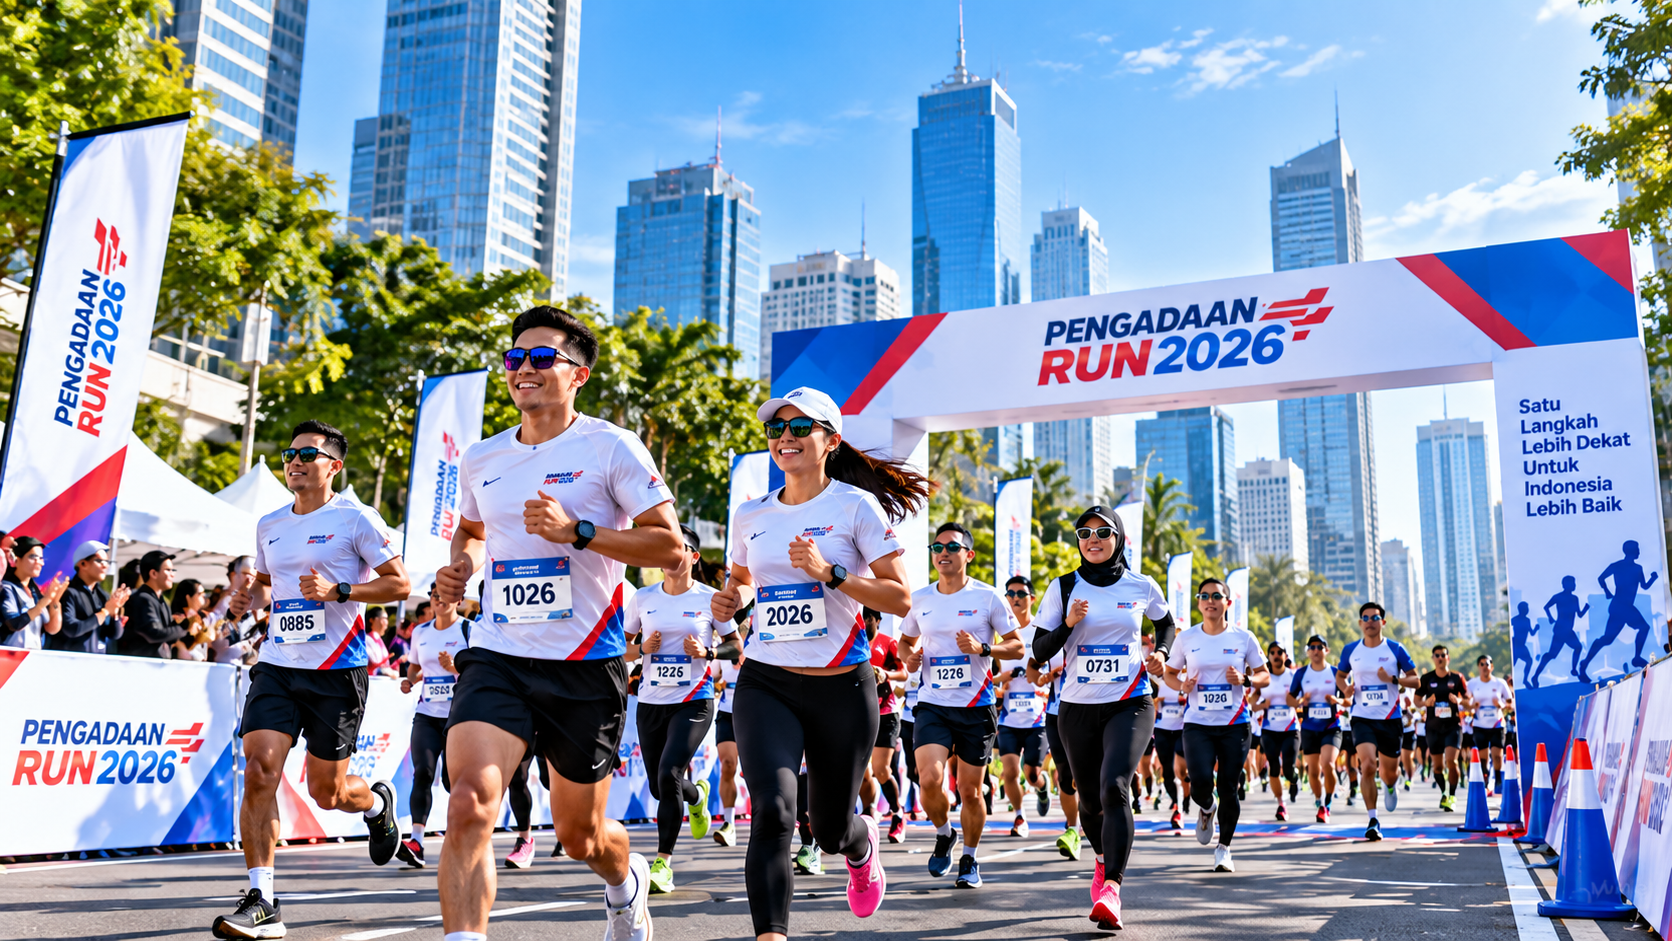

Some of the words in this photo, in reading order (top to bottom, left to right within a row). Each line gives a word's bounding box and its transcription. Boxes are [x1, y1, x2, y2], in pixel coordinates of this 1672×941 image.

[91, 279, 127, 365] 2026
[1044, 296, 1258, 346] PENGADAAN
[54, 269, 100, 427] PENGADAAN
[1037, 338, 1153, 387] RUN
[1152, 324, 1286, 375] 2026
[76, 361, 114, 437] RUN
[1519, 398, 1561, 414] Satu
[1521, 413, 1598, 435] Langkah
[1522, 436, 1572, 454] Lebih
[1576, 432, 1631, 450] Dekat
[1523, 457, 1579, 476] Untuk
[1525, 476, 1613, 496] Indonesia
[1526, 499, 1577, 517] Lebih
[1582, 495, 1623, 514] Baik
[503, 582, 556, 606] 1026
[280, 614, 315, 632] 0885
[766, 604, 813, 626] 2026
[1085, 658, 1119, 673] 0731
[20, 719, 166, 745] PENGADAAN
[12, 750, 97, 786] RUN
[96, 750, 177, 785] 2026
